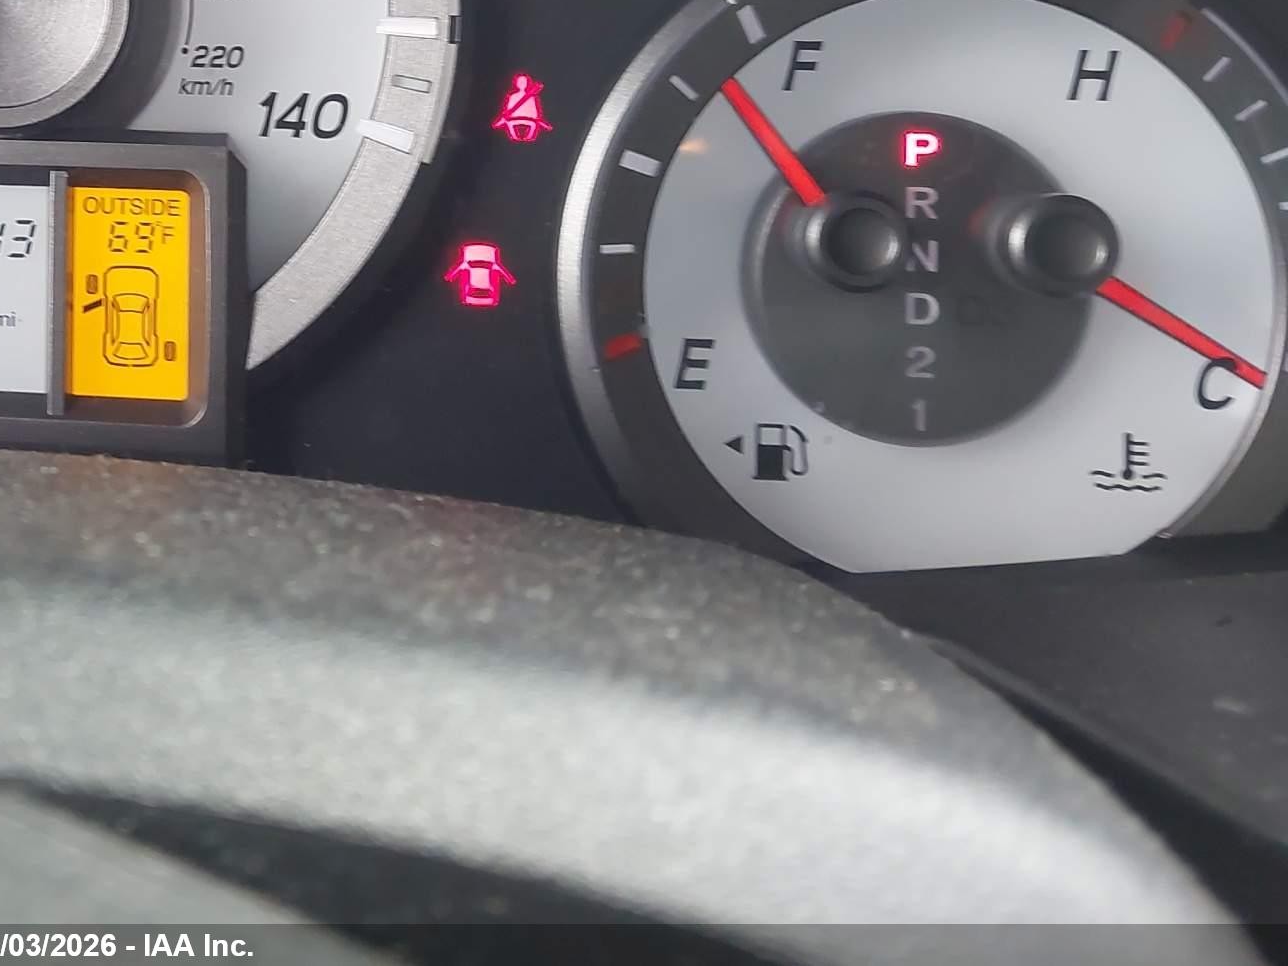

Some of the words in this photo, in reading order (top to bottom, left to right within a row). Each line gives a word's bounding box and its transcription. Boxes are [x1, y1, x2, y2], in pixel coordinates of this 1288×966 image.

[190, 45, 244, 69] 220
[782, 40, 823, 91] F
[178, 78, 234, 96] km/h
[1067, 49, 1119, 101] H
[258, 93, 349, 139] 140
[904, 132, 940, 167] P
[83, 196, 181, 216] OUTSIDE
[904, 186, 939, 219] R
[905, 240, 939, 273] N
[904, 292, 940, 325] D
[674, 338, 715, 390] E
[904, 346, 936, 378] 2
[1194, 357, 1237, 410] C
[912, 399, 927, 432] 1
